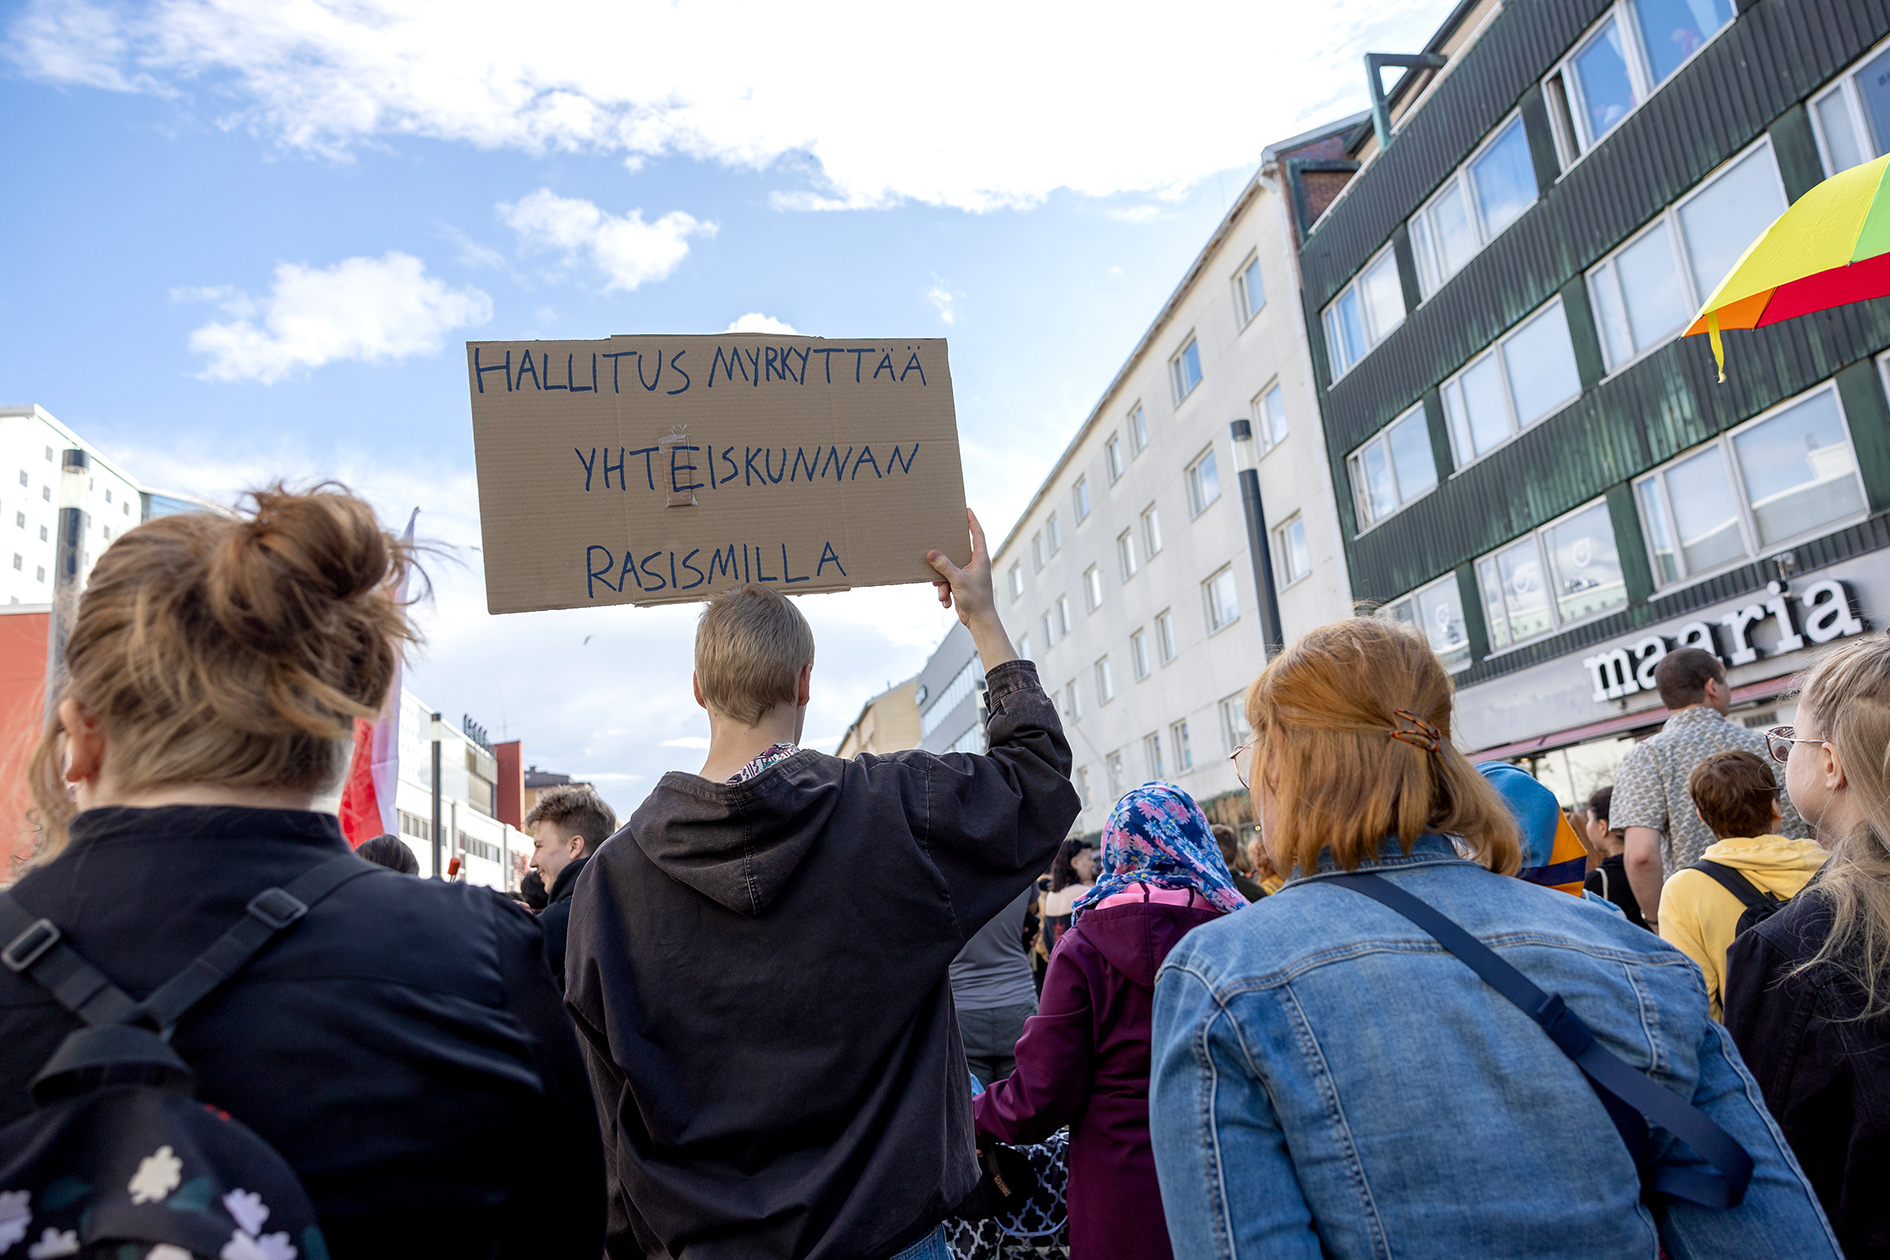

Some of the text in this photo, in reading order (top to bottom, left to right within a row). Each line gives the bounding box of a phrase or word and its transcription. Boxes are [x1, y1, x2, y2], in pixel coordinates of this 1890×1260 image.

[474, 346, 927, 395] HALLITUS MYRKYTTÄÄ
[575, 443, 919, 492] YHTEISKUNNAN
[587, 542, 846, 598] RASISMILLA
